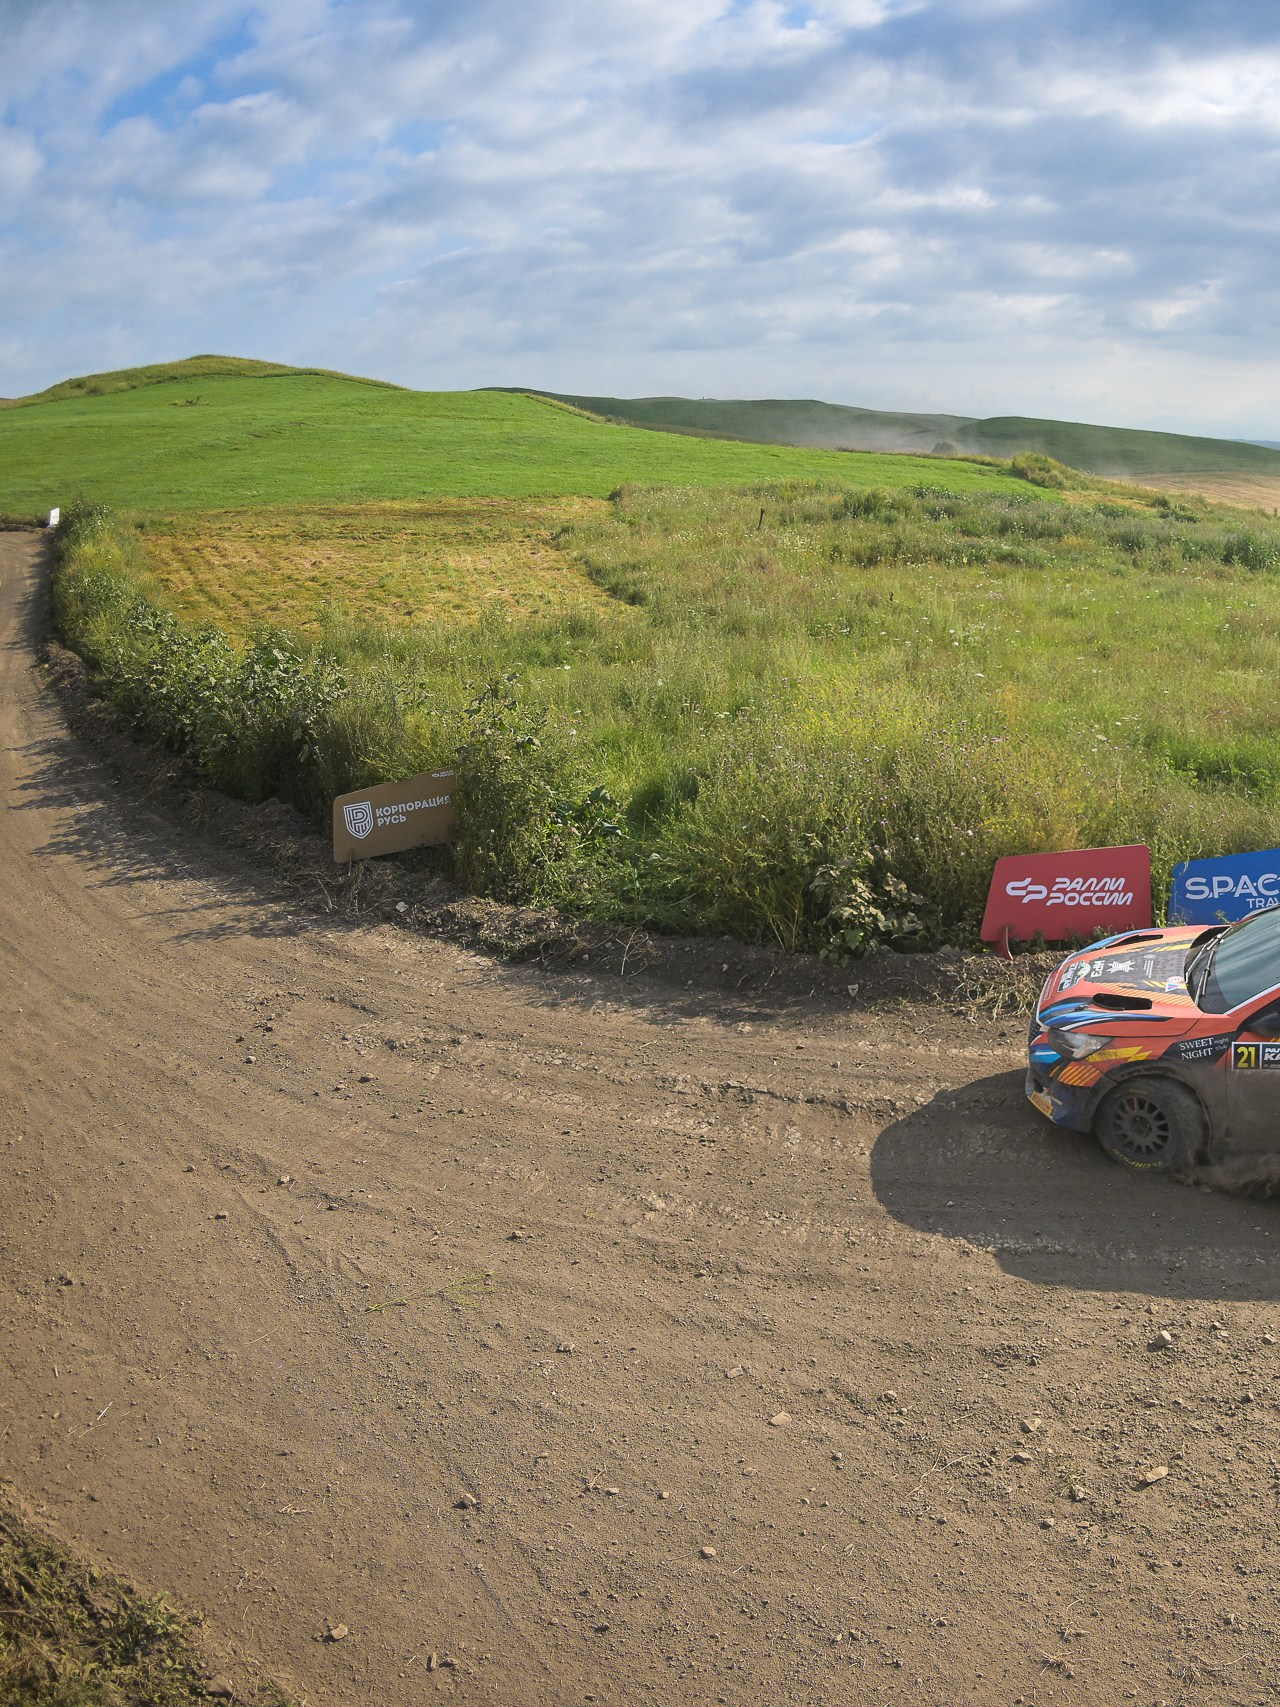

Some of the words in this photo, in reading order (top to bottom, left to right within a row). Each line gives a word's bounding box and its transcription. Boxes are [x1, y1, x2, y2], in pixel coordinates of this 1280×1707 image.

[375, 795, 451, 817] КОРПОРАЦИЯ
[377, 813, 407, 827] РУСЬ
[1051, 877, 1126, 891] РАЛЛИ
[1045, 892, 1134, 906] РОССИИ
[1179, 1037, 1214, 1051] SWEET
[1181, 1047, 1213, 1061] NIGHT
[1237, 1046, 1256, 1068] 21
